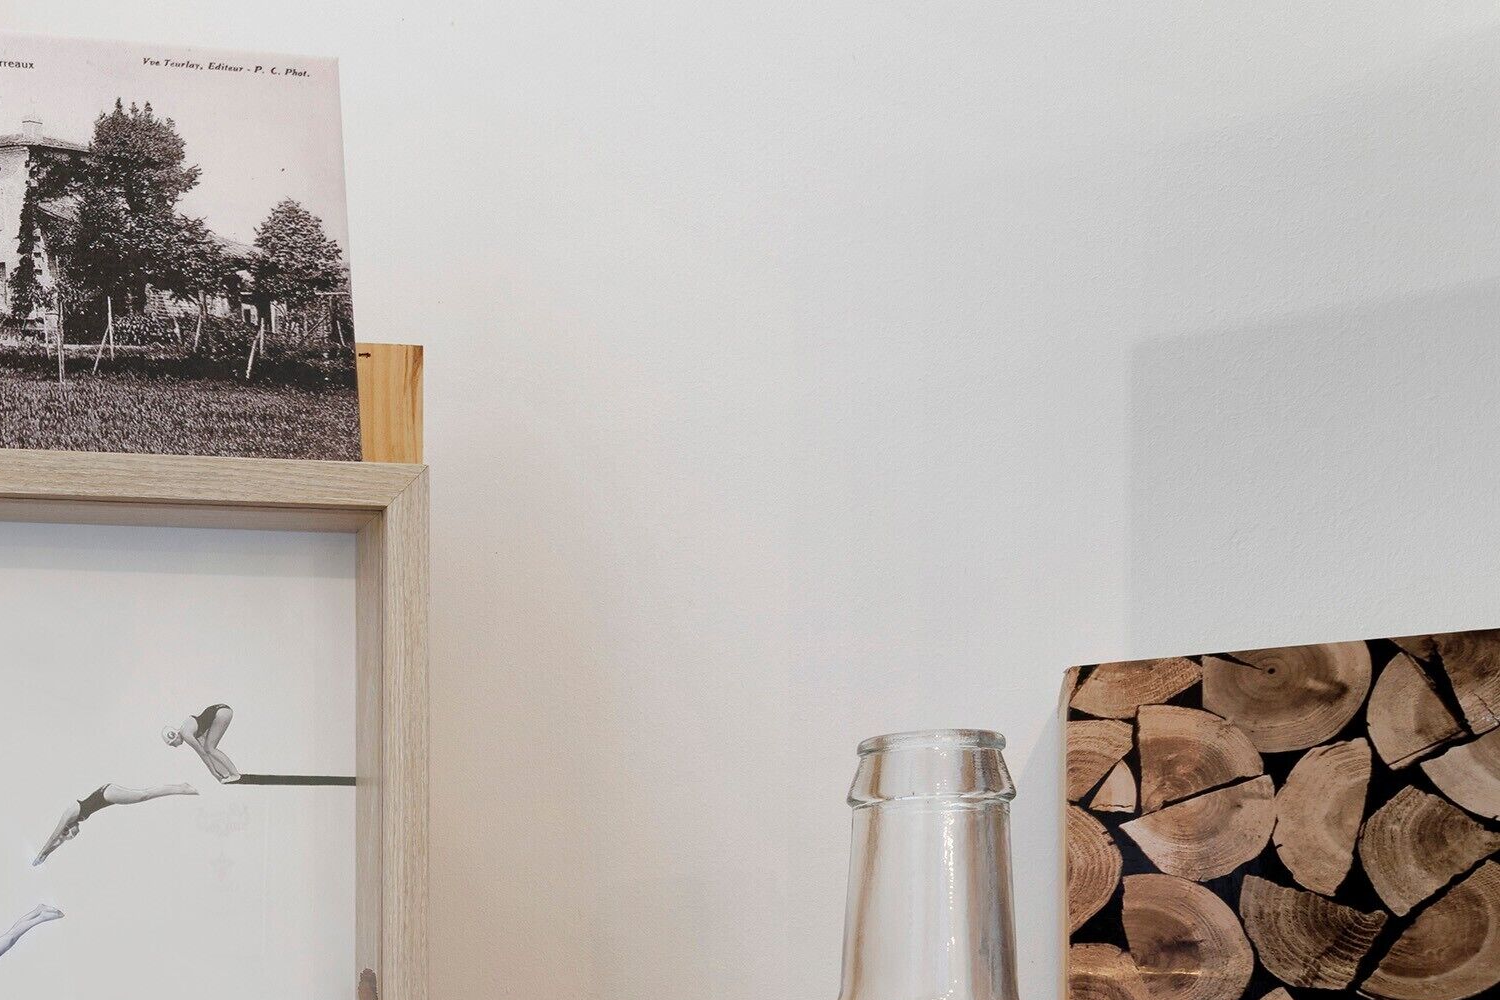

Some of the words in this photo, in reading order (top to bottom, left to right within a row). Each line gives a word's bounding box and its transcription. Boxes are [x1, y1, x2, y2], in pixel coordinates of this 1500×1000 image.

[207, 61, 244, 73] Editeur
[254, 65, 265, 74] P.
[284, 68, 311, 78] Phot.
